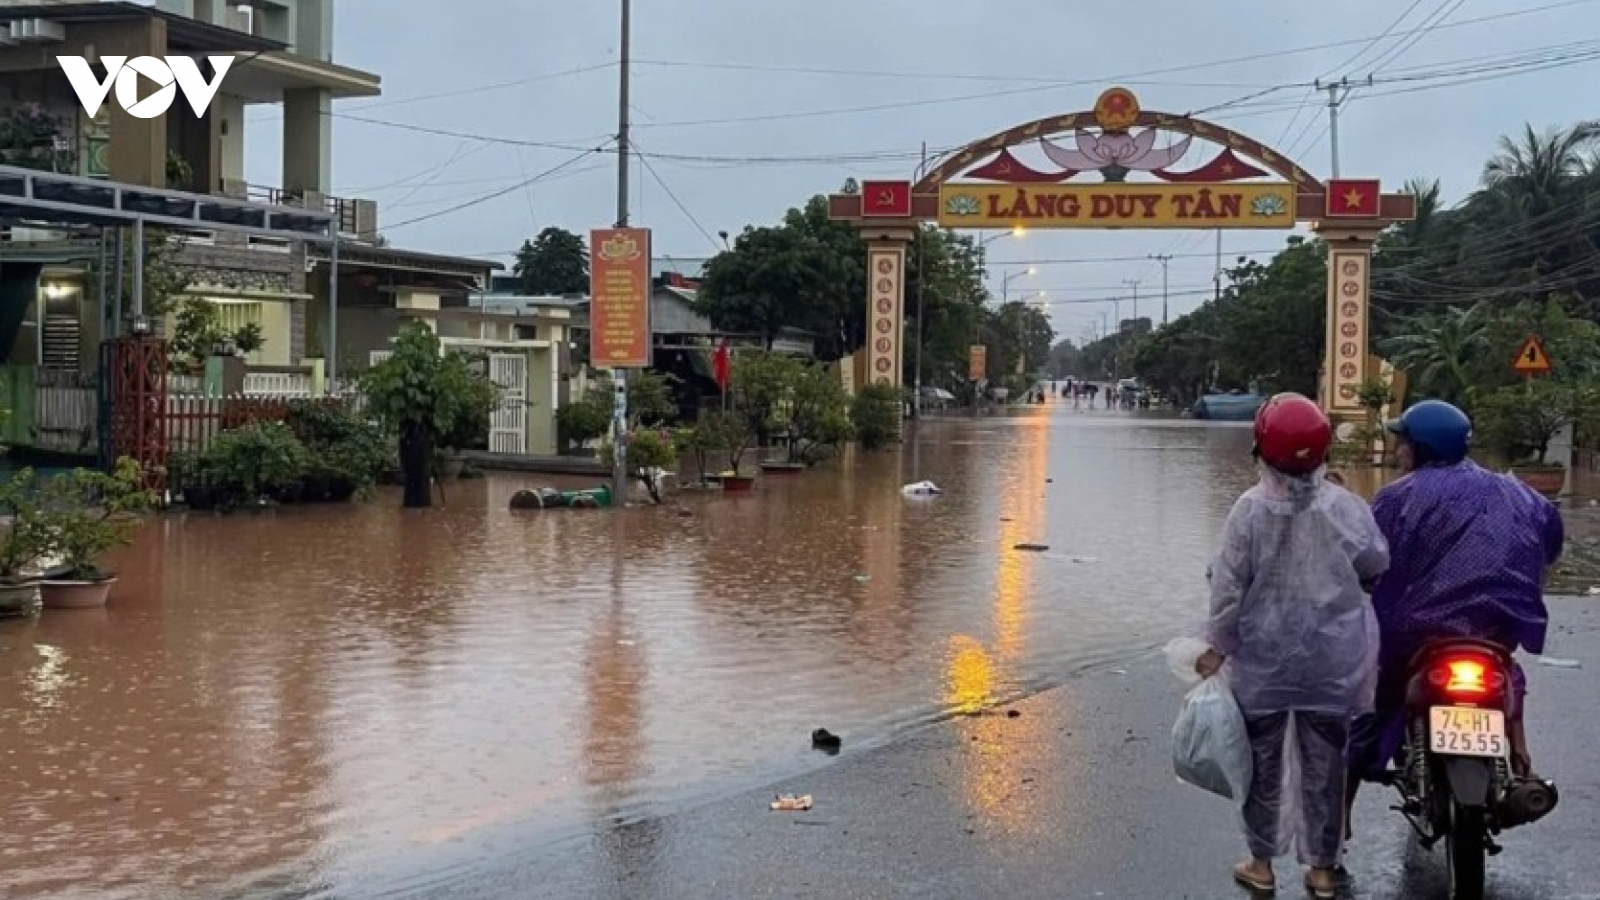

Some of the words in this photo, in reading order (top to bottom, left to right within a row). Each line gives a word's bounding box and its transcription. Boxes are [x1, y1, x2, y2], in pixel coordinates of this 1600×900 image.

[988, 188, 1080, 218] LÀNG
[1090, 194, 1163, 218] DUY
[1171, 188, 1243, 218] TÂN
[1442, 710, 1490, 732] 74-H1
[1436, 730, 1501, 753] 325.55
